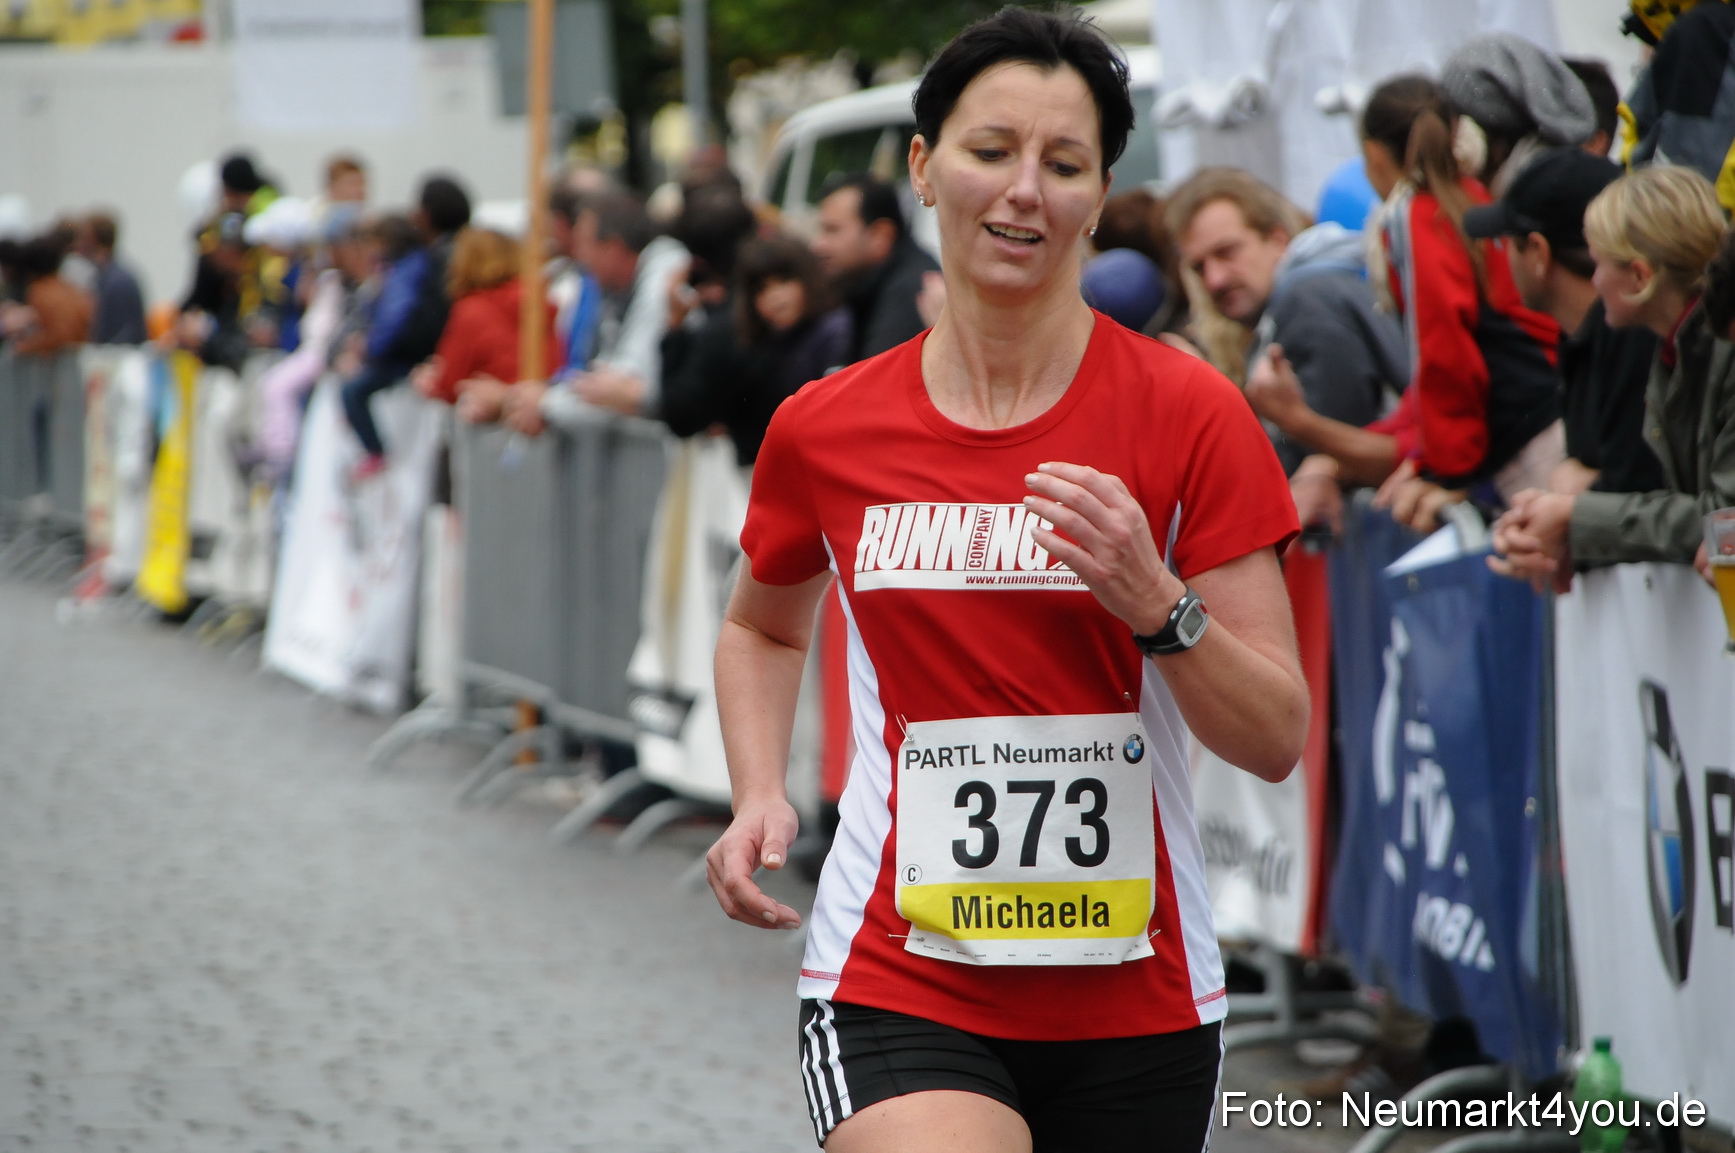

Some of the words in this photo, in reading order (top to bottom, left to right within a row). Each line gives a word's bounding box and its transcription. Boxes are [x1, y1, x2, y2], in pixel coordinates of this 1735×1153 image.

[968, 508, 993, 568] COMPANY
[904, 744, 986, 770] PARTL
[993, 741, 1114, 764] Neumarkt
[951, 777, 1111, 869] 373
[908, 867, 916, 882] C
[951, 894, 1110, 930] Michaela
